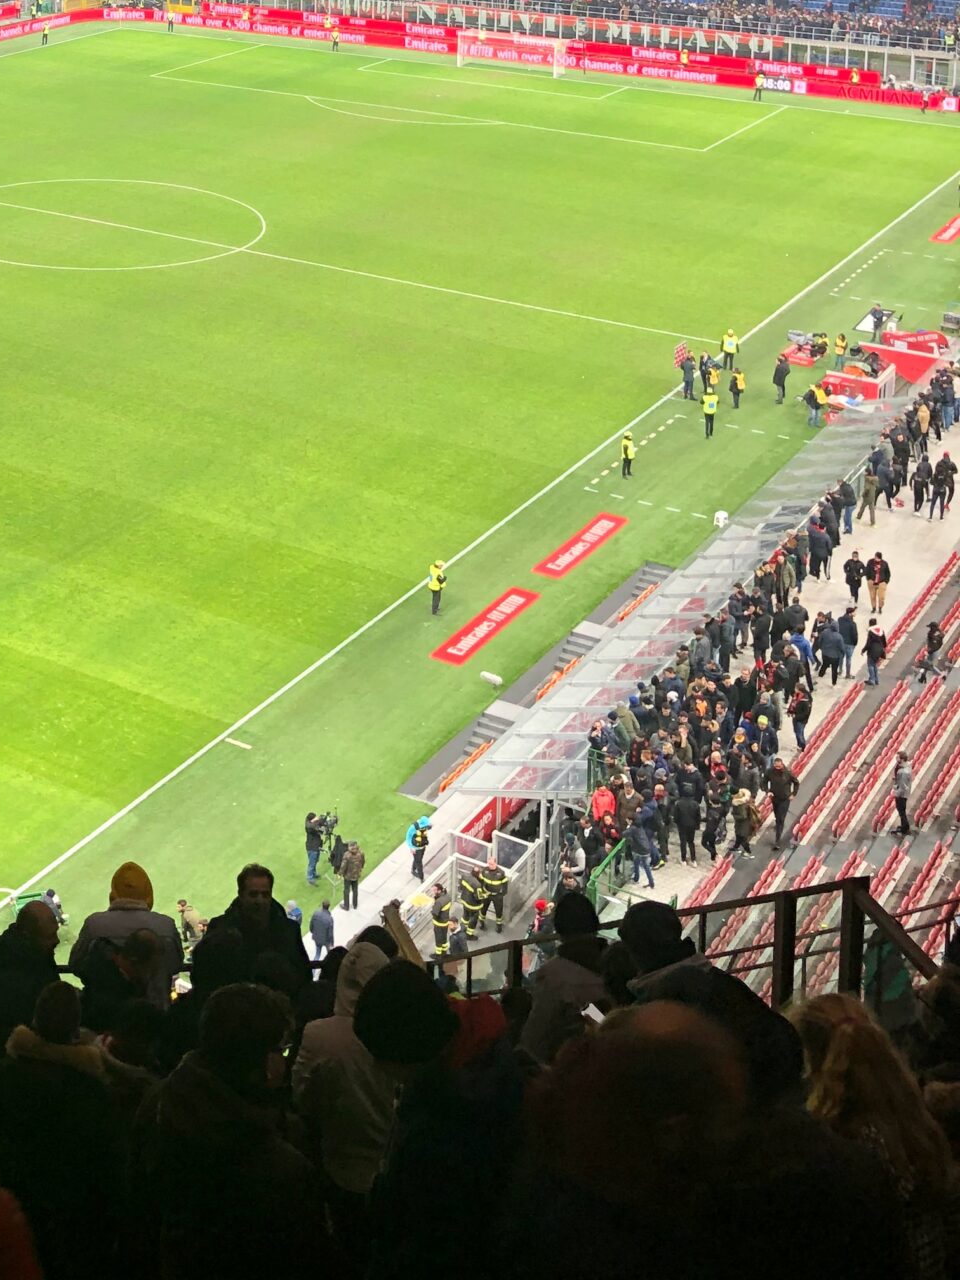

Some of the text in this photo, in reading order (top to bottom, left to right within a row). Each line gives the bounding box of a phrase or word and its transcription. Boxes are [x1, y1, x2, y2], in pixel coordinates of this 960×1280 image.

[103, 8, 145, 20] Emirates
[185, 15, 203, 25] with
[205, 18, 224, 27] over
[225, 18, 250, 31] 4,500
[252, 22, 289, 35] channels
[291, 25, 301, 36] of
[405, 23, 445, 38] Emirates
[605, 20, 773, 54] MILANO
[404, 36, 449, 53] Emirates
[496, 49, 518, 61] with
[521, 52, 543, 63] over
[579, 59, 624, 73] channels
[627, 63, 639, 74] of
[641, 66, 717, 83] entertainment
[632, 47, 677, 61] Emirates
[754, 60, 804, 76] Emirates
[546, 541, 591, 571] Emirates
[446, 621, 496, 656] Emirates
